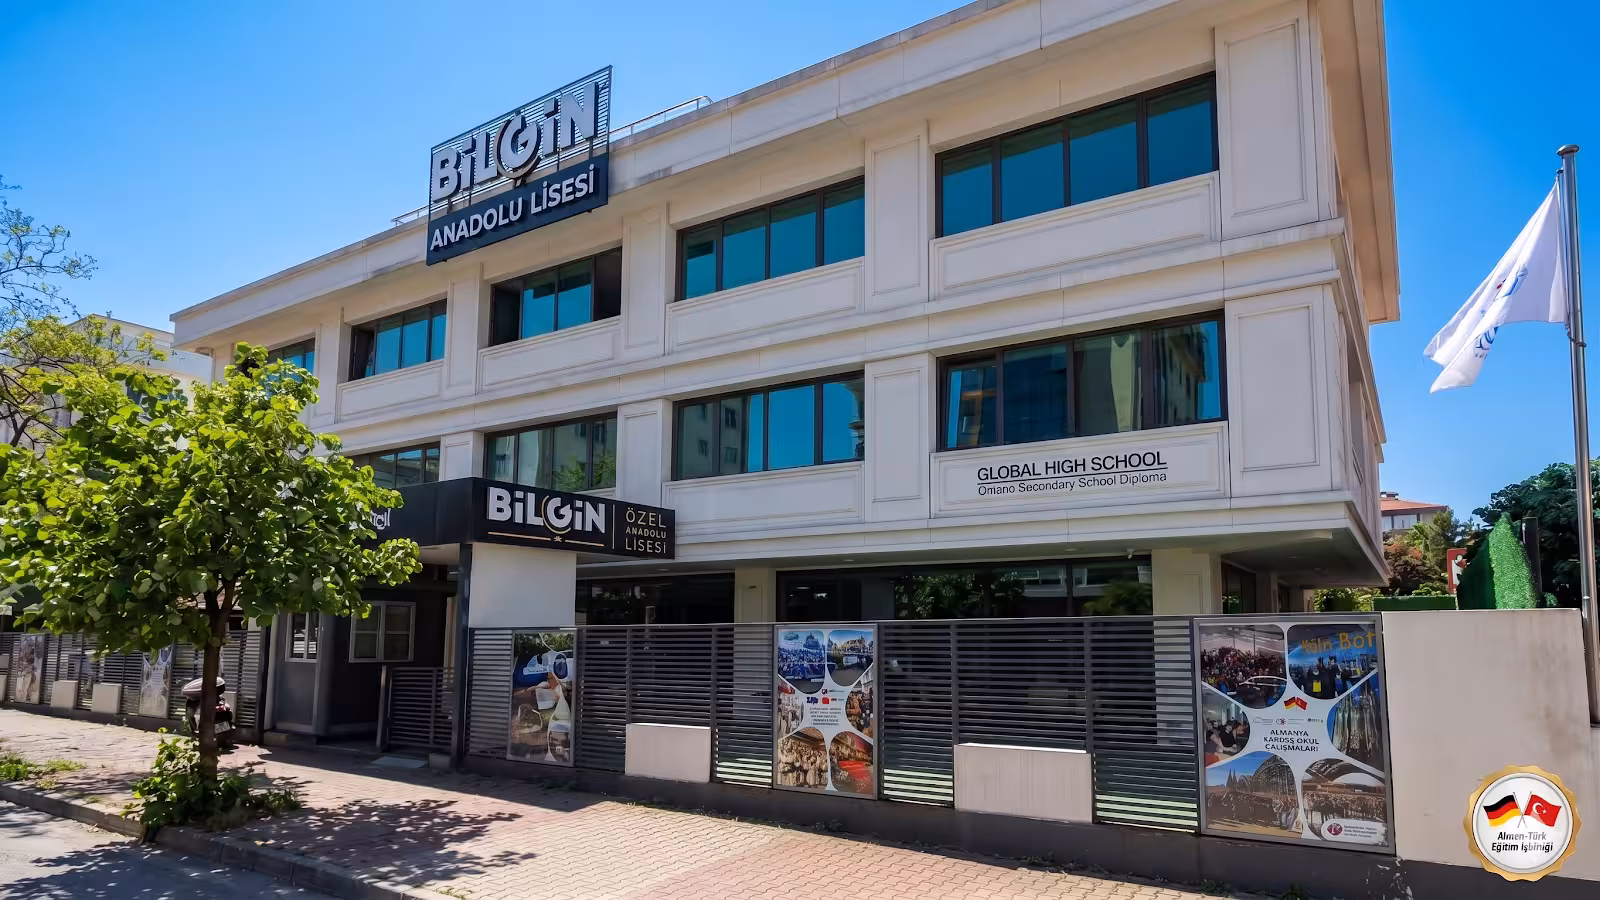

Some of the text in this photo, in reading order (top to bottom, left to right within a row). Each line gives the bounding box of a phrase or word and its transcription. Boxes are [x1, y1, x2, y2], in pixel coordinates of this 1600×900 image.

[430, 163, 595, 251] ANADOLU LİSESİ
[977, 451, 1167, 481] GLOBAL HIGH SCHOOL
[1018, 478, 1075, 492] Secondary
[1078, 476, 1116, 488] School
[1120, 472, 1167, 485] Diploma
[625, 507, 666, 528] ÖZEL
[625, 526, 666, 539] ANADOLU
[625, 536, 666, 554] LİSESİ
[1270, 729, 1309, 737] ALMANYA
